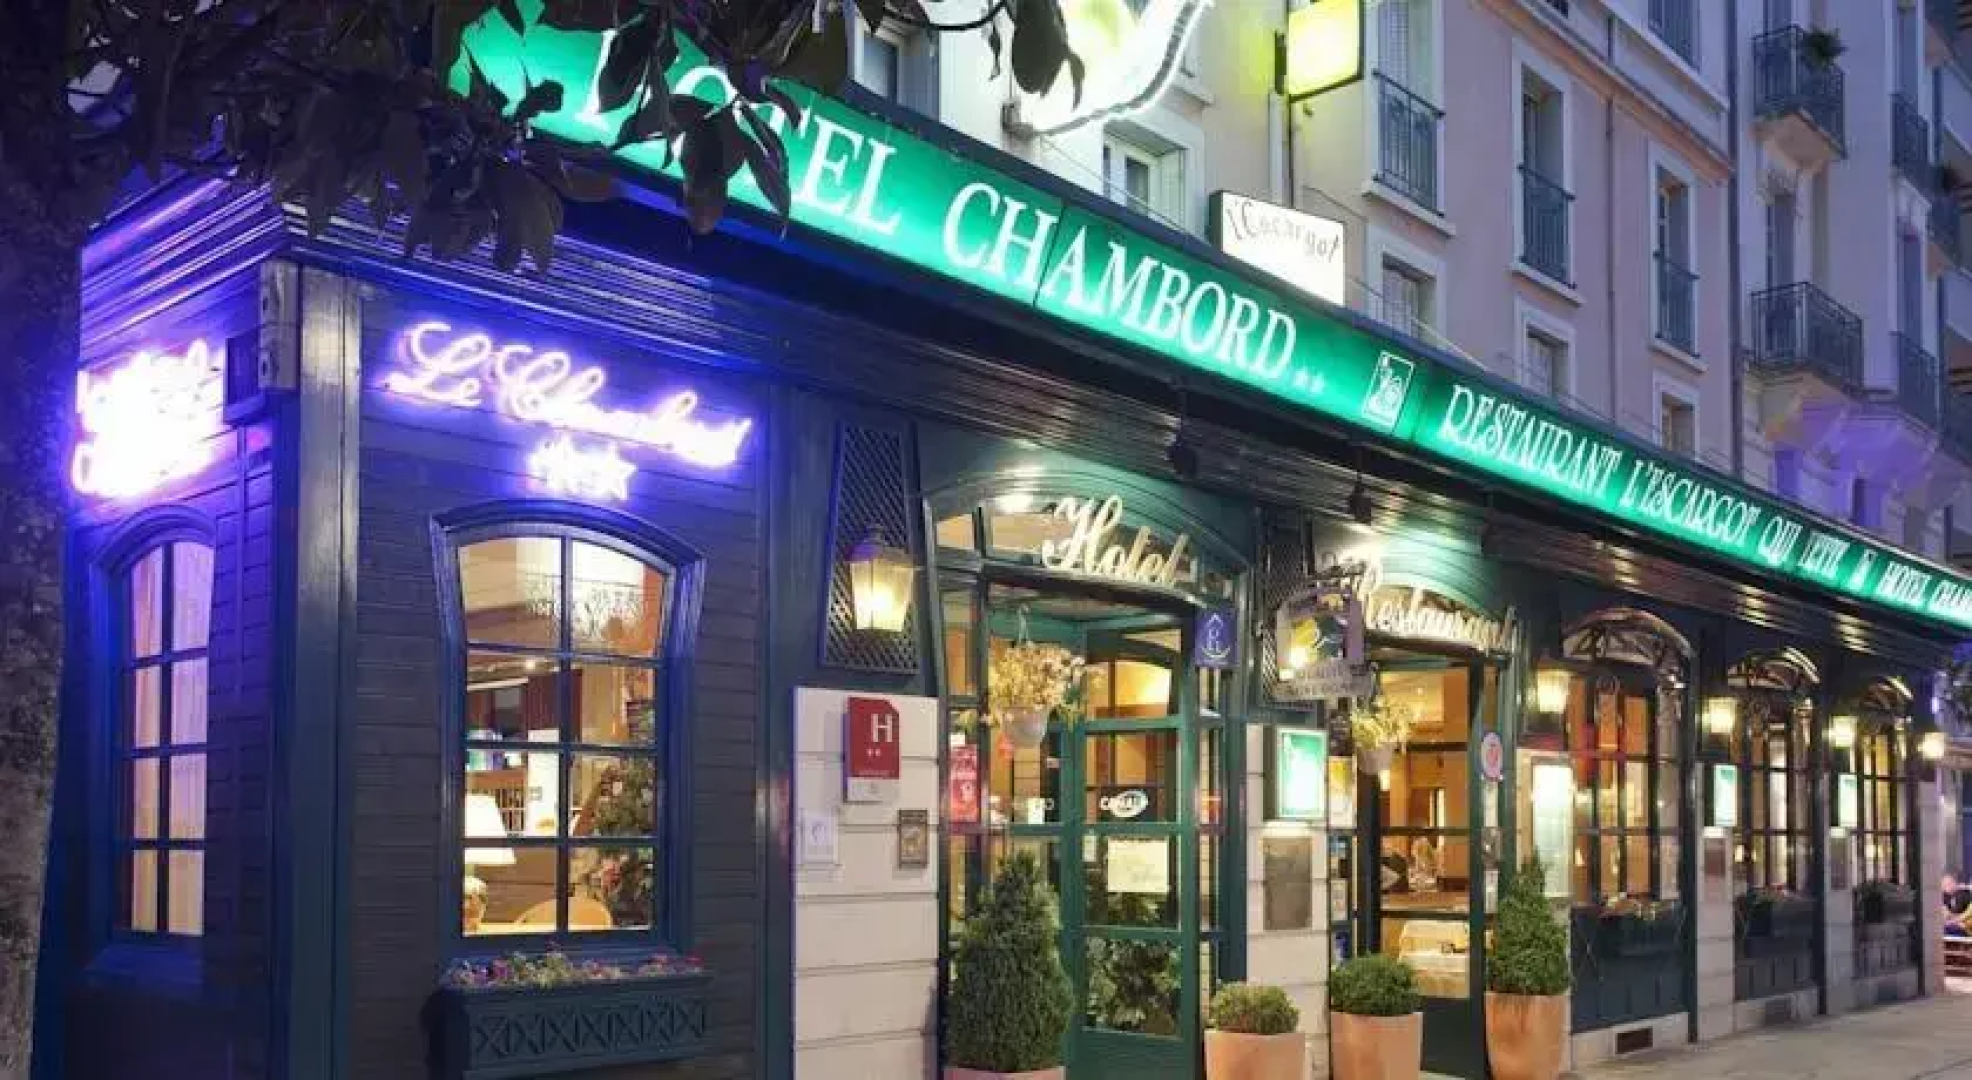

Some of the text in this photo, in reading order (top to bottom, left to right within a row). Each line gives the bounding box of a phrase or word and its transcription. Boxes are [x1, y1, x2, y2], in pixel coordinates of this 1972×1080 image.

[943, 181, 1297, 384] CHAMBORD
[381, 321, 492, 407] Le
[1439, 384, 1623, 500] RESTAURANT
[871, 713, 894, 743] H
